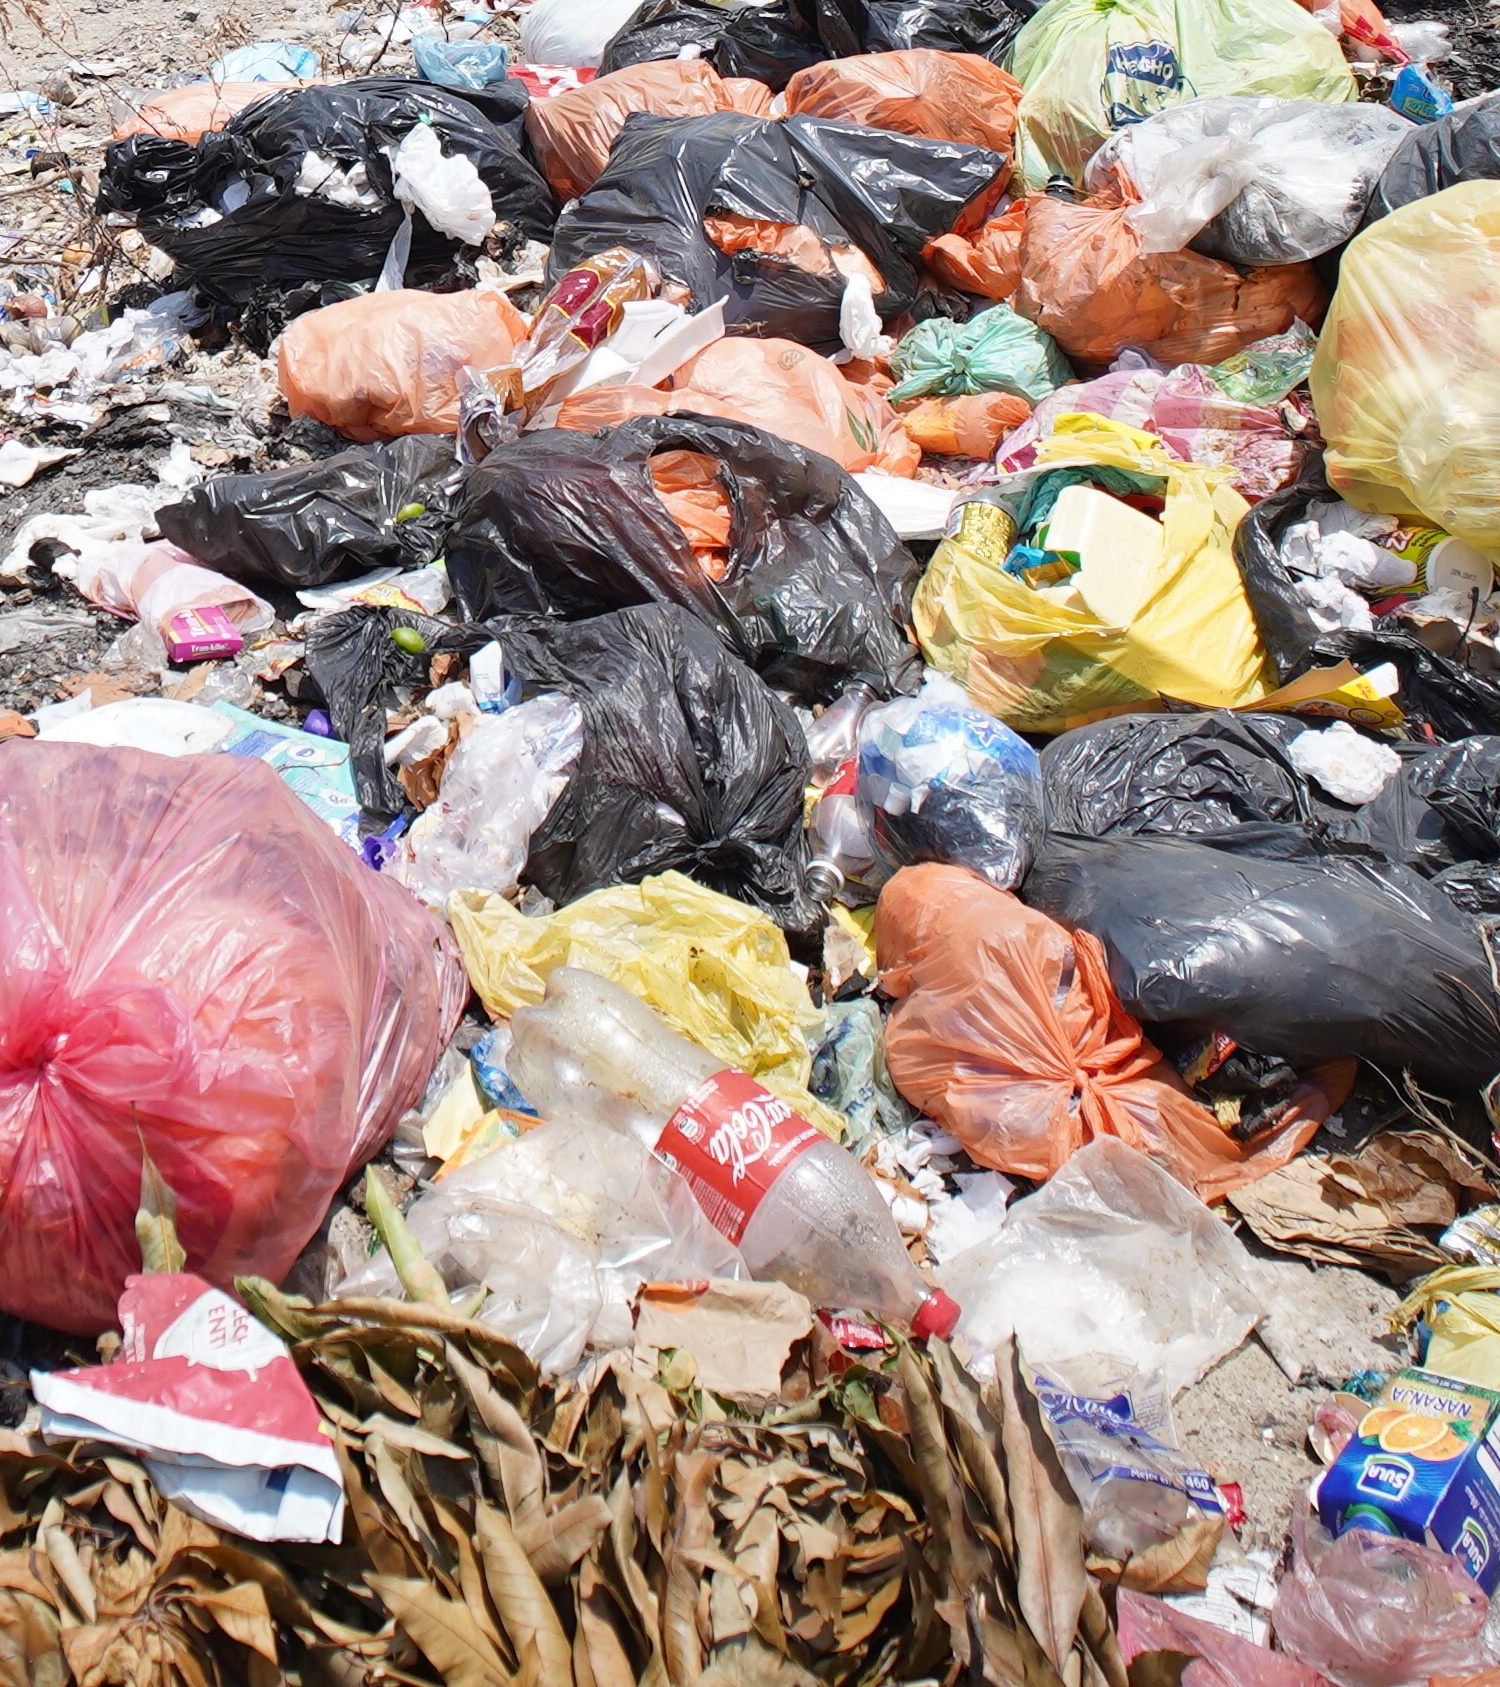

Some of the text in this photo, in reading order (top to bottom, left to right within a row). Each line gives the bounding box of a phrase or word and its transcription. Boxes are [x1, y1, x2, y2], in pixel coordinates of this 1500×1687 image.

[1390, 1386, 1473, 1419] NARANJA
[1185, 1474, 1209, 1491] 460
[1368, 1465, 1409, 1490] SULA
[1461, 1532, 1484, 1572] SULA
